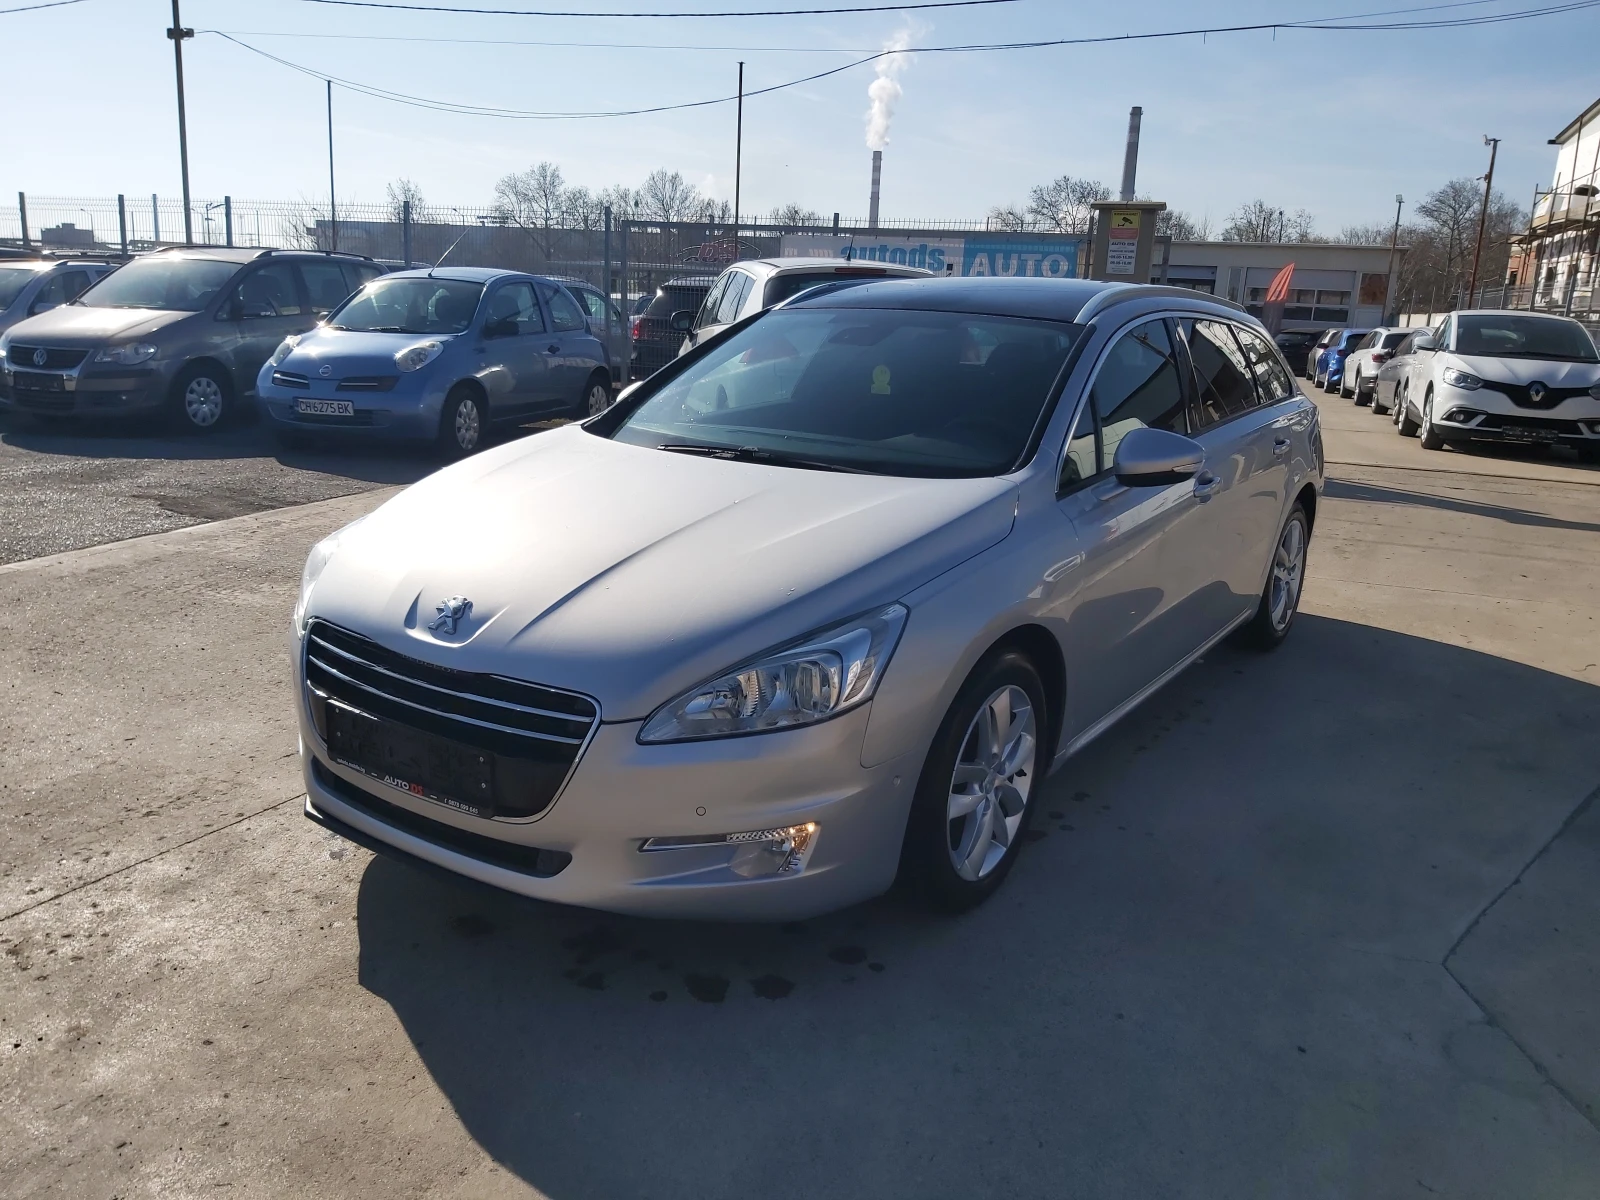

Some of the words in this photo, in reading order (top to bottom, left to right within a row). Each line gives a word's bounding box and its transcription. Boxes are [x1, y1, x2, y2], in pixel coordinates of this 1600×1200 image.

[967, 252, 1069, 277] AUTO
[384, 774, 409, 790] AUTO
[409, 782, 425, 797] DS
